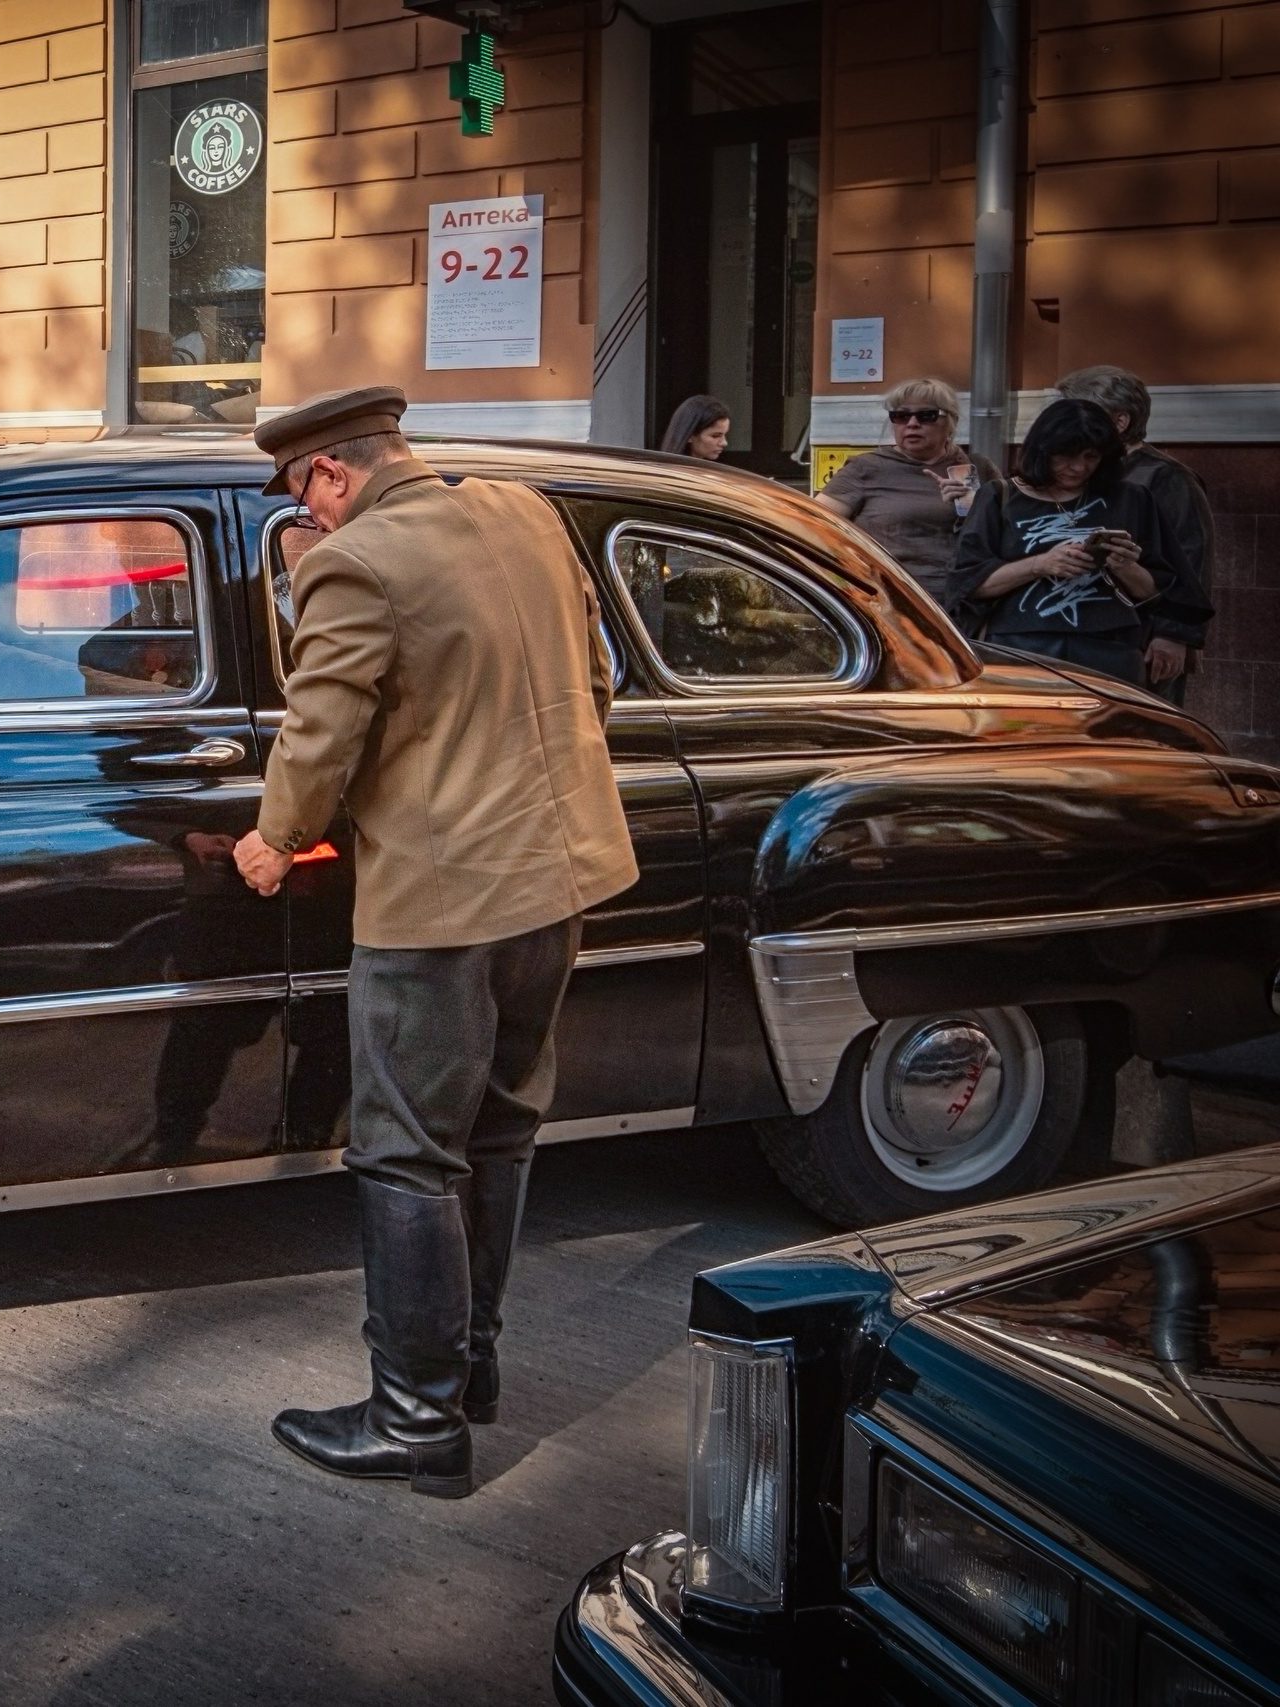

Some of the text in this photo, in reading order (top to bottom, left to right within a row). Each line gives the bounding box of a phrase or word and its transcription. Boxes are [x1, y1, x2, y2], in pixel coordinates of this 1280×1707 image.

[190, 103, 248, 129] STARS
[187, 163, 247, 190] COFFEE
[441, 207, 529, 229] Аптека
[441, 245, 529, 283] 9-22
